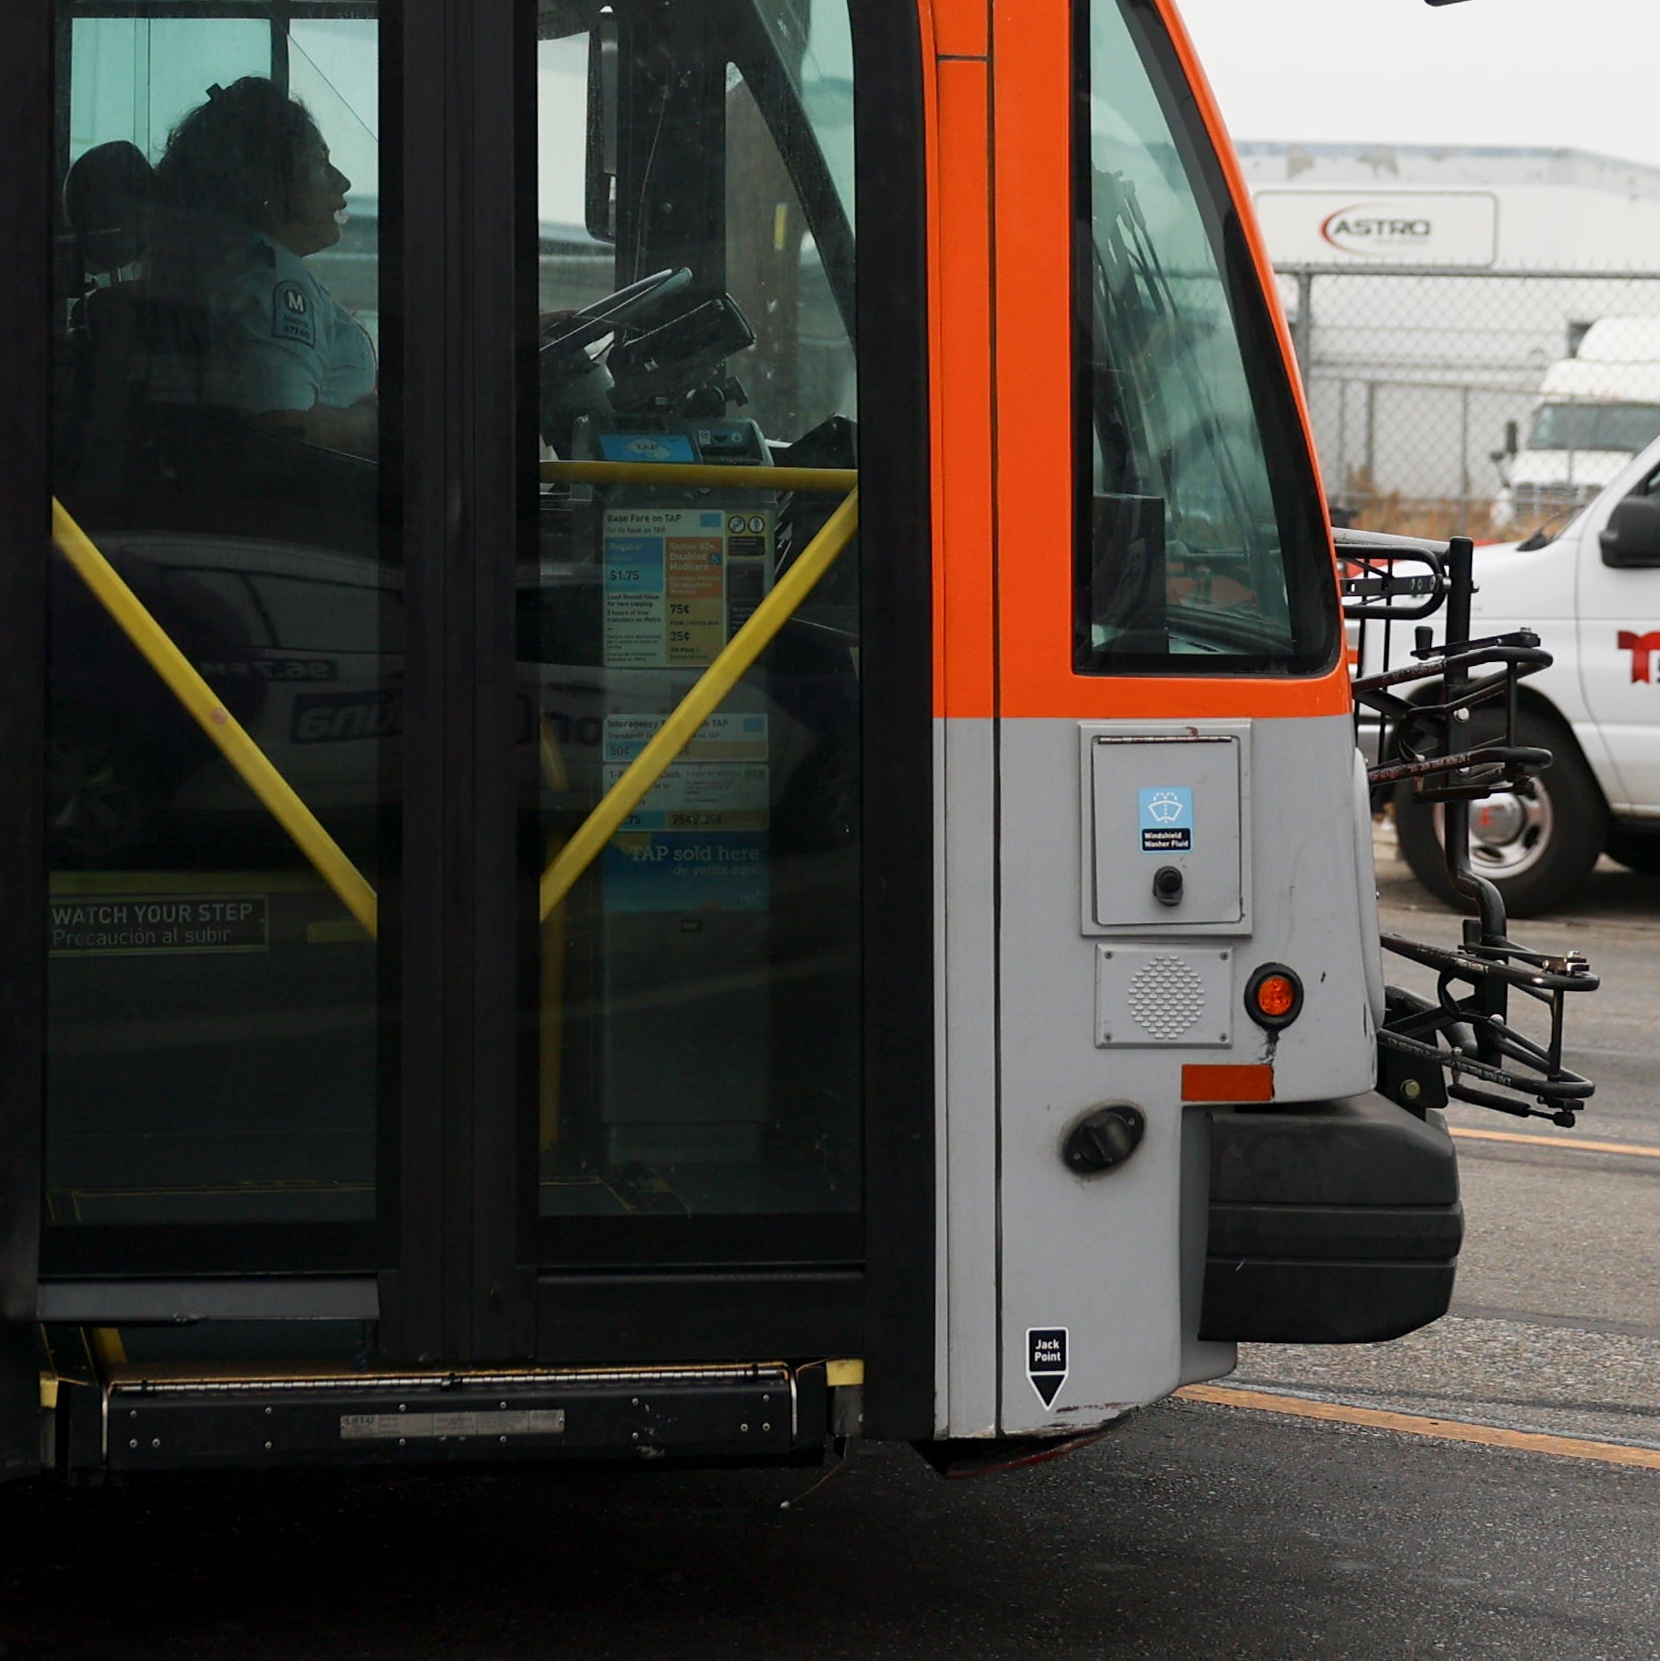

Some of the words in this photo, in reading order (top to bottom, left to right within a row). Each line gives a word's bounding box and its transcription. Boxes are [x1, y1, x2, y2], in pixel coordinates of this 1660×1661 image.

[1334, 219, 1432, 236] ASTRO
[607, 514, 629, 523] Base
[630, 514, 650, 523] Fare
[665, 514, 682, 522] TAP
[609, 569, 640, 582] $1.75
[670, 604, 689, 615] 75¢
[670, 631, 690, 642] 35¢
[712, 719, 728, 728] TAP
[1144, 831, 1182, 839] Windshield
[1171, 839, 1189, 847] Fluid
[629, 844, 669, 861] TAP
[673, 844, 712, 861] sold
[717, 844, 760, 861] here
[51, 906, 128, 925] WATCH
[133, 904, 192, 923] YOUR
[198, 903, 253, 922] STEP
[53, 927, 156, 947] Precaución
[162, 926, 180, 944] al
[184, 925, 232, 944] subir
[1035, 1338, 1060, 1350] Jack
[1034, 1351, 1061, 1362] Point
